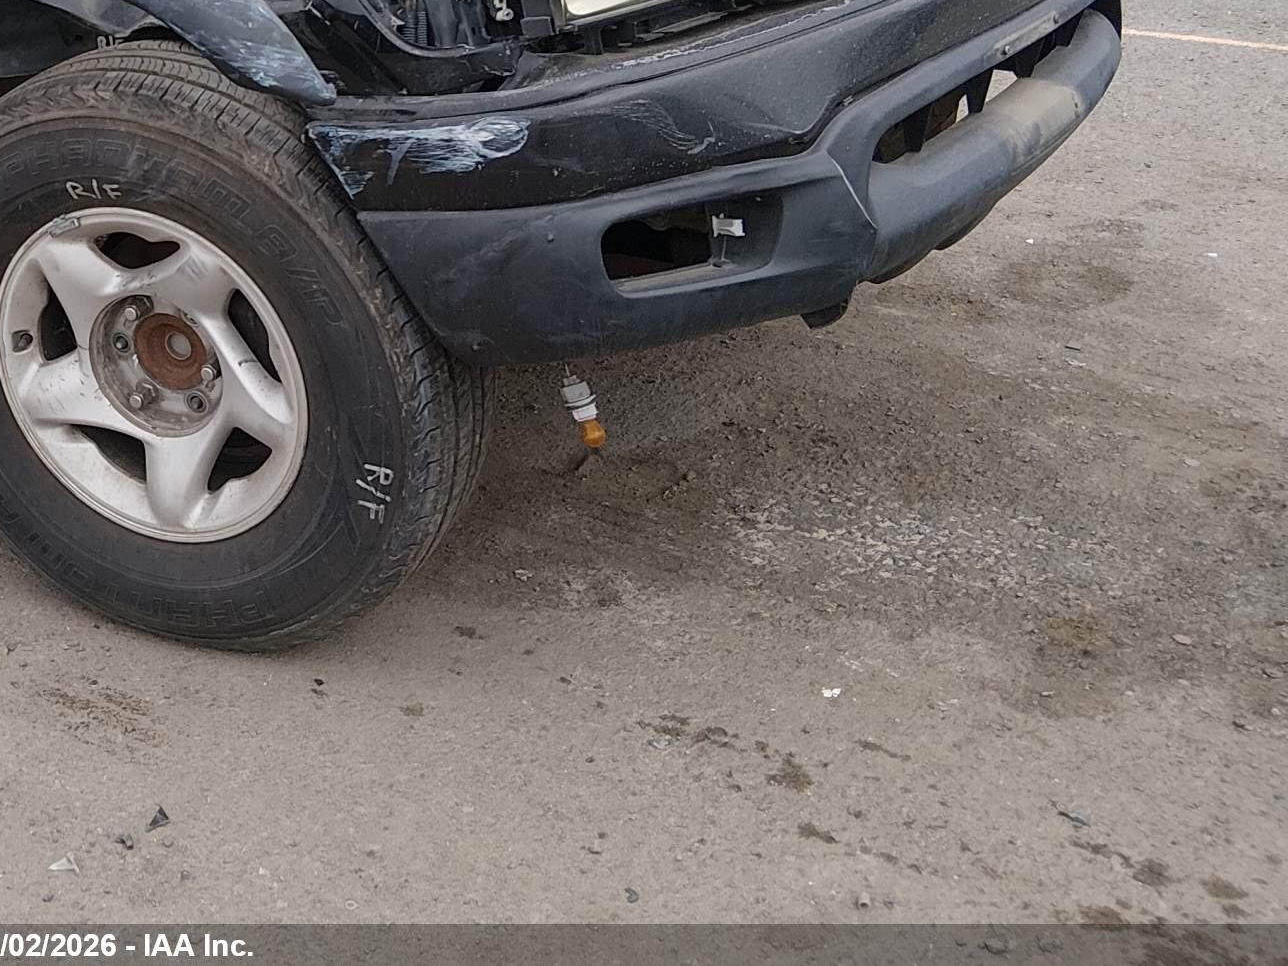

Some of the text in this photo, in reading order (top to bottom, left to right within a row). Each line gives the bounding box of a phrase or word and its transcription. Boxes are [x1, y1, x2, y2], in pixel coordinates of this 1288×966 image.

[6, 137, 251, 225] PHANTOM
[65, 178, 123, 202] R/F
[355, 463, 394, 525] R/F
